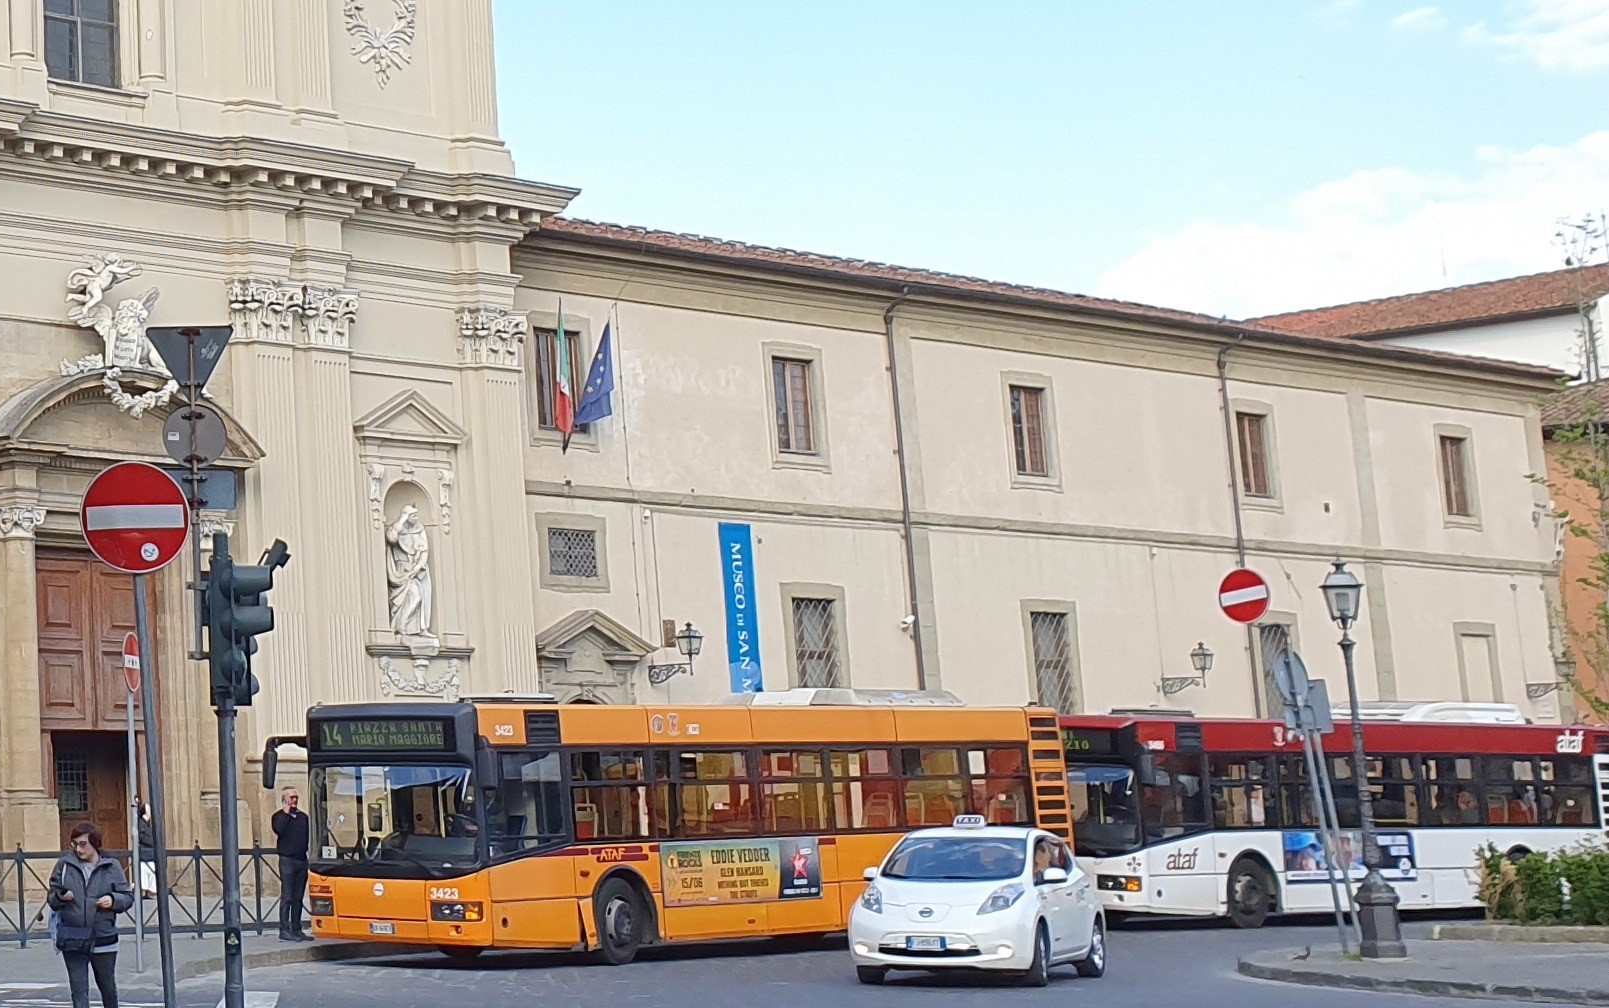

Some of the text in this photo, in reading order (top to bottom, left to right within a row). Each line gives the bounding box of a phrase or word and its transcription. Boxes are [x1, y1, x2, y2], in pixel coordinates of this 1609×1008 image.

[730, 542, 746, 609] MUSEO
[736, 614, 745, 626] DI
[737, 630, 751, 670] SAN
[322, 722, 342, 746] 14
[349, 721, 443, 733] PIAZZA SANTA
[351, 733, 443, 745] MARIA MAGGIORE
[1556, 729, 1584, 753] ataf
[600, 848, 626, 861] ATAF
[710, 848, 736, 864] EDDIE
[737, 847, 770, 863] VEDDER
[1166, 847, 1199, 870] ataf
[429, 887, 459, 900] 3423
